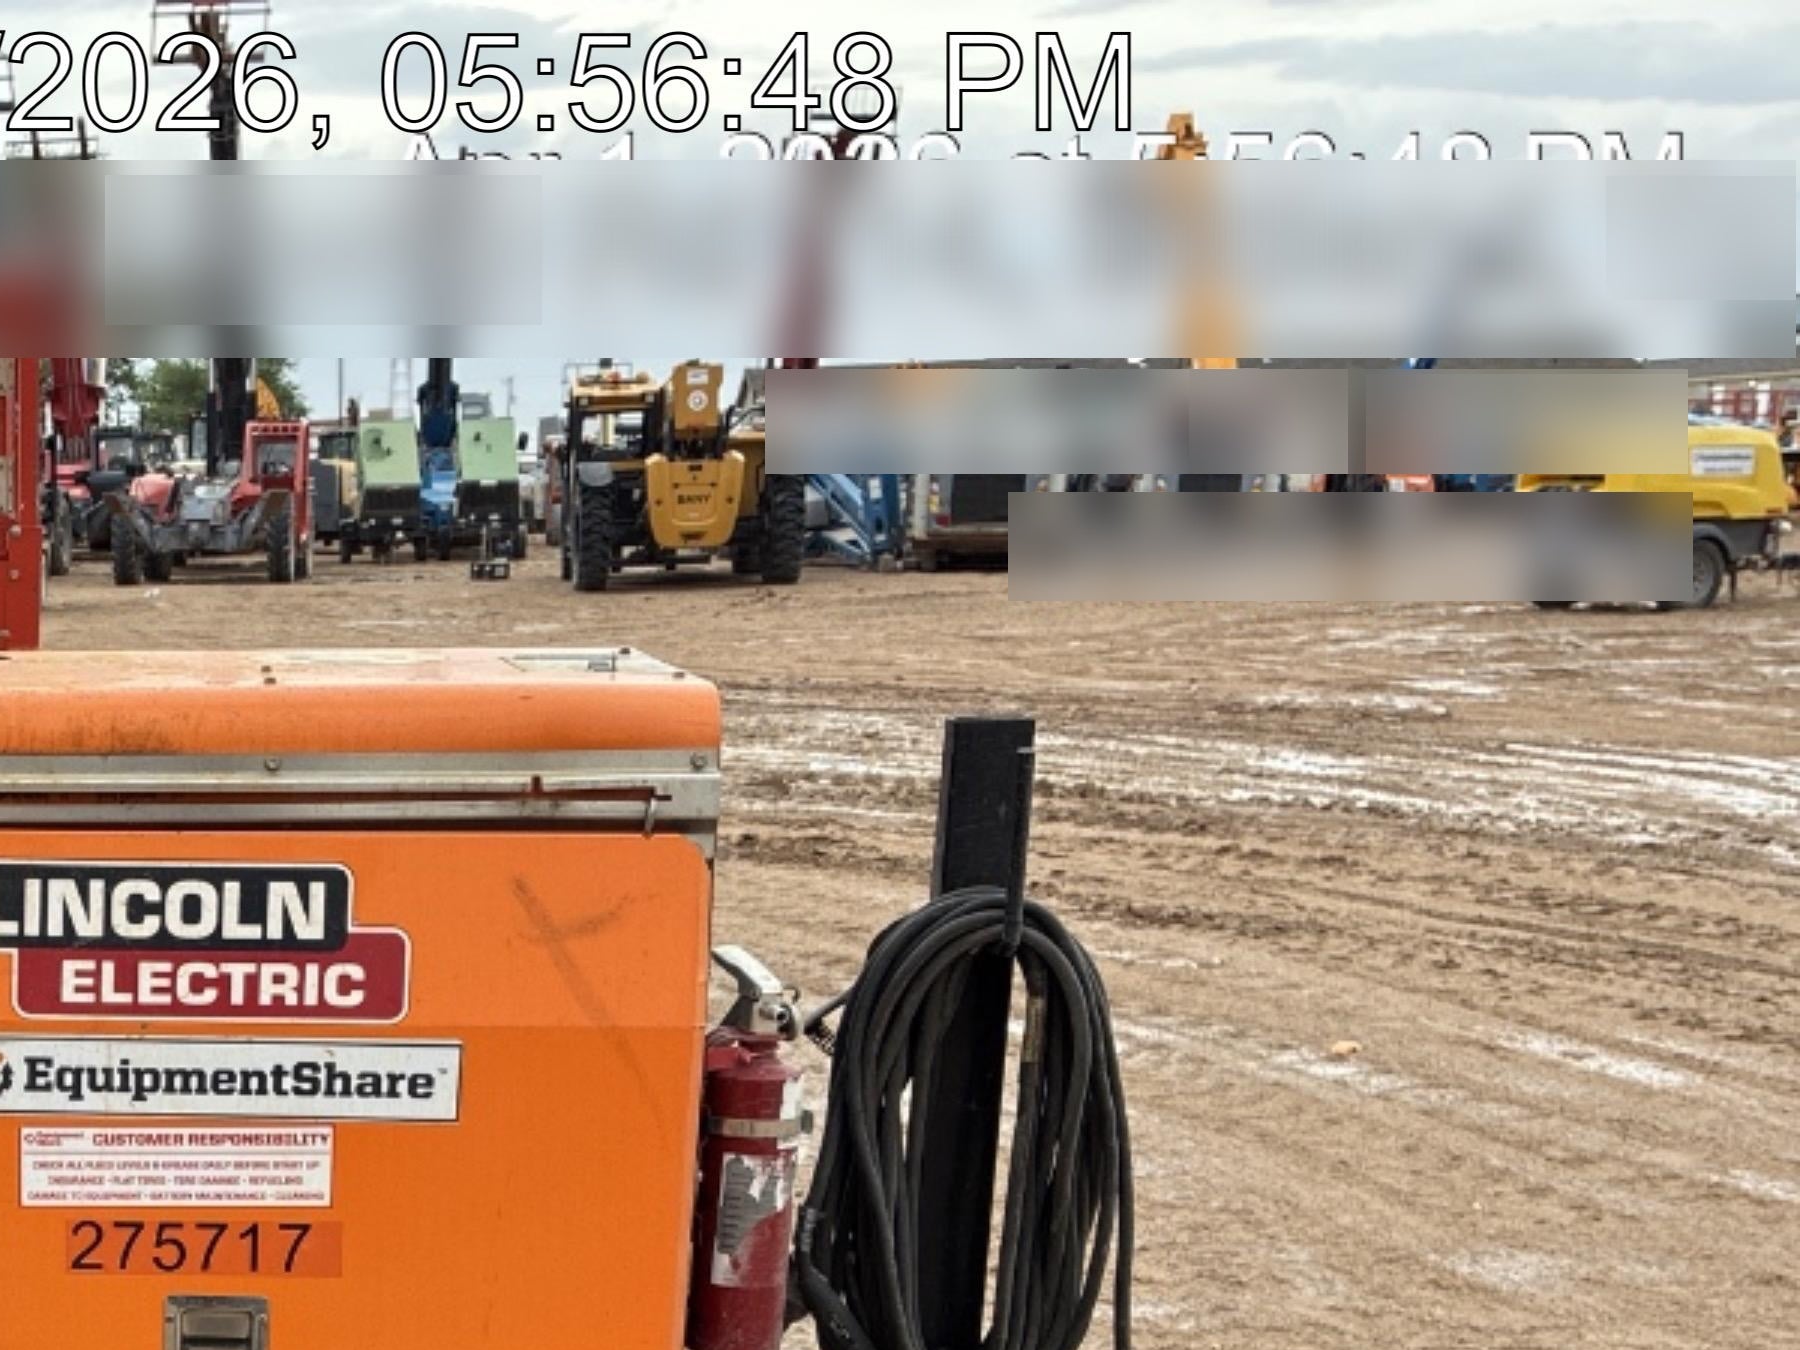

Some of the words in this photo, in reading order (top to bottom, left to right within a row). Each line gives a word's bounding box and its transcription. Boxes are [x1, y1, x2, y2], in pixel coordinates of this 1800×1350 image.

[60, 958, 366, 1008] ELECTRIC
[23, 1055, 436, 1102] EquipmentShare
[92, 1133, 184, 1146] CUSTOMER
[188, 1133, 330, 1146] RESPONSIBILITY
[69, 1219, 312, 1274] 275717
